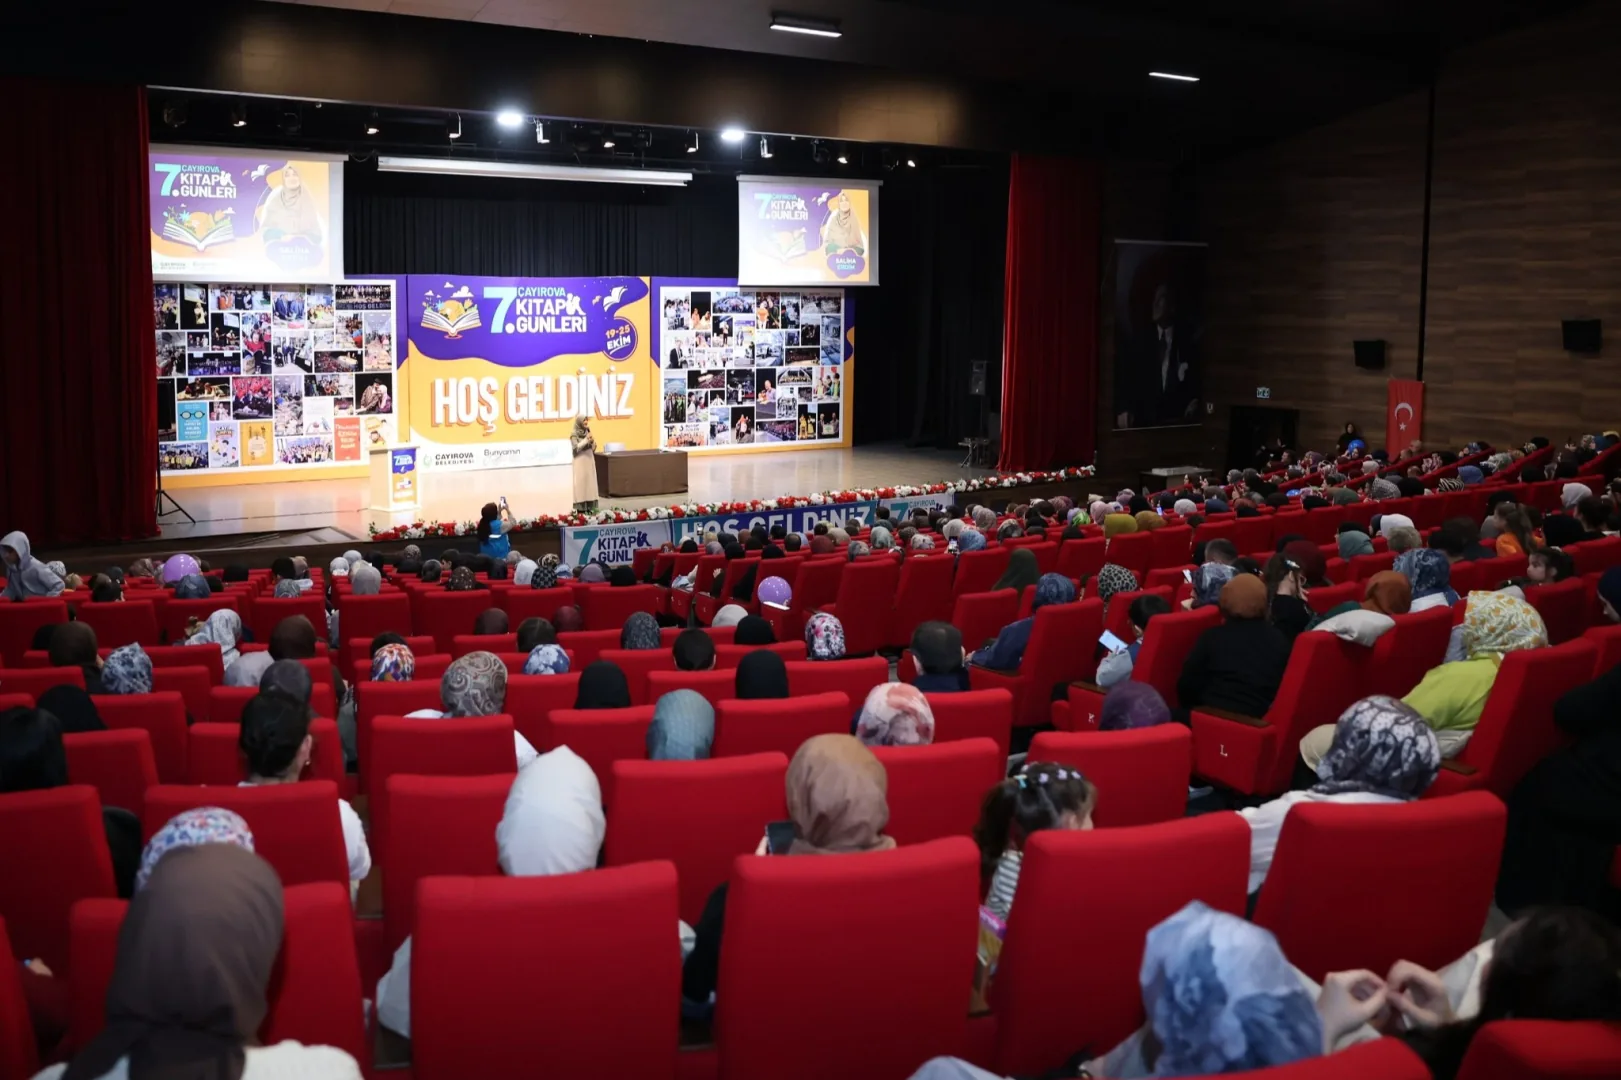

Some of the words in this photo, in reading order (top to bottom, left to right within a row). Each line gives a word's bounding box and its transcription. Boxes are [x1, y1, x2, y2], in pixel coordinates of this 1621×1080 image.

[155, 163, 180, 197] 7.
[483, 286, 517, 334] 7.
[605, 324, 631, 339] 19-25
[606, 334, 631, 350] EKİM
[432, 376, 499, 434] HOŞ
[505, 366, 635, 423] GELDİNİZ
[598, 536, 637, 551] KİTAP
[1220, 744, 1228, 756] L
